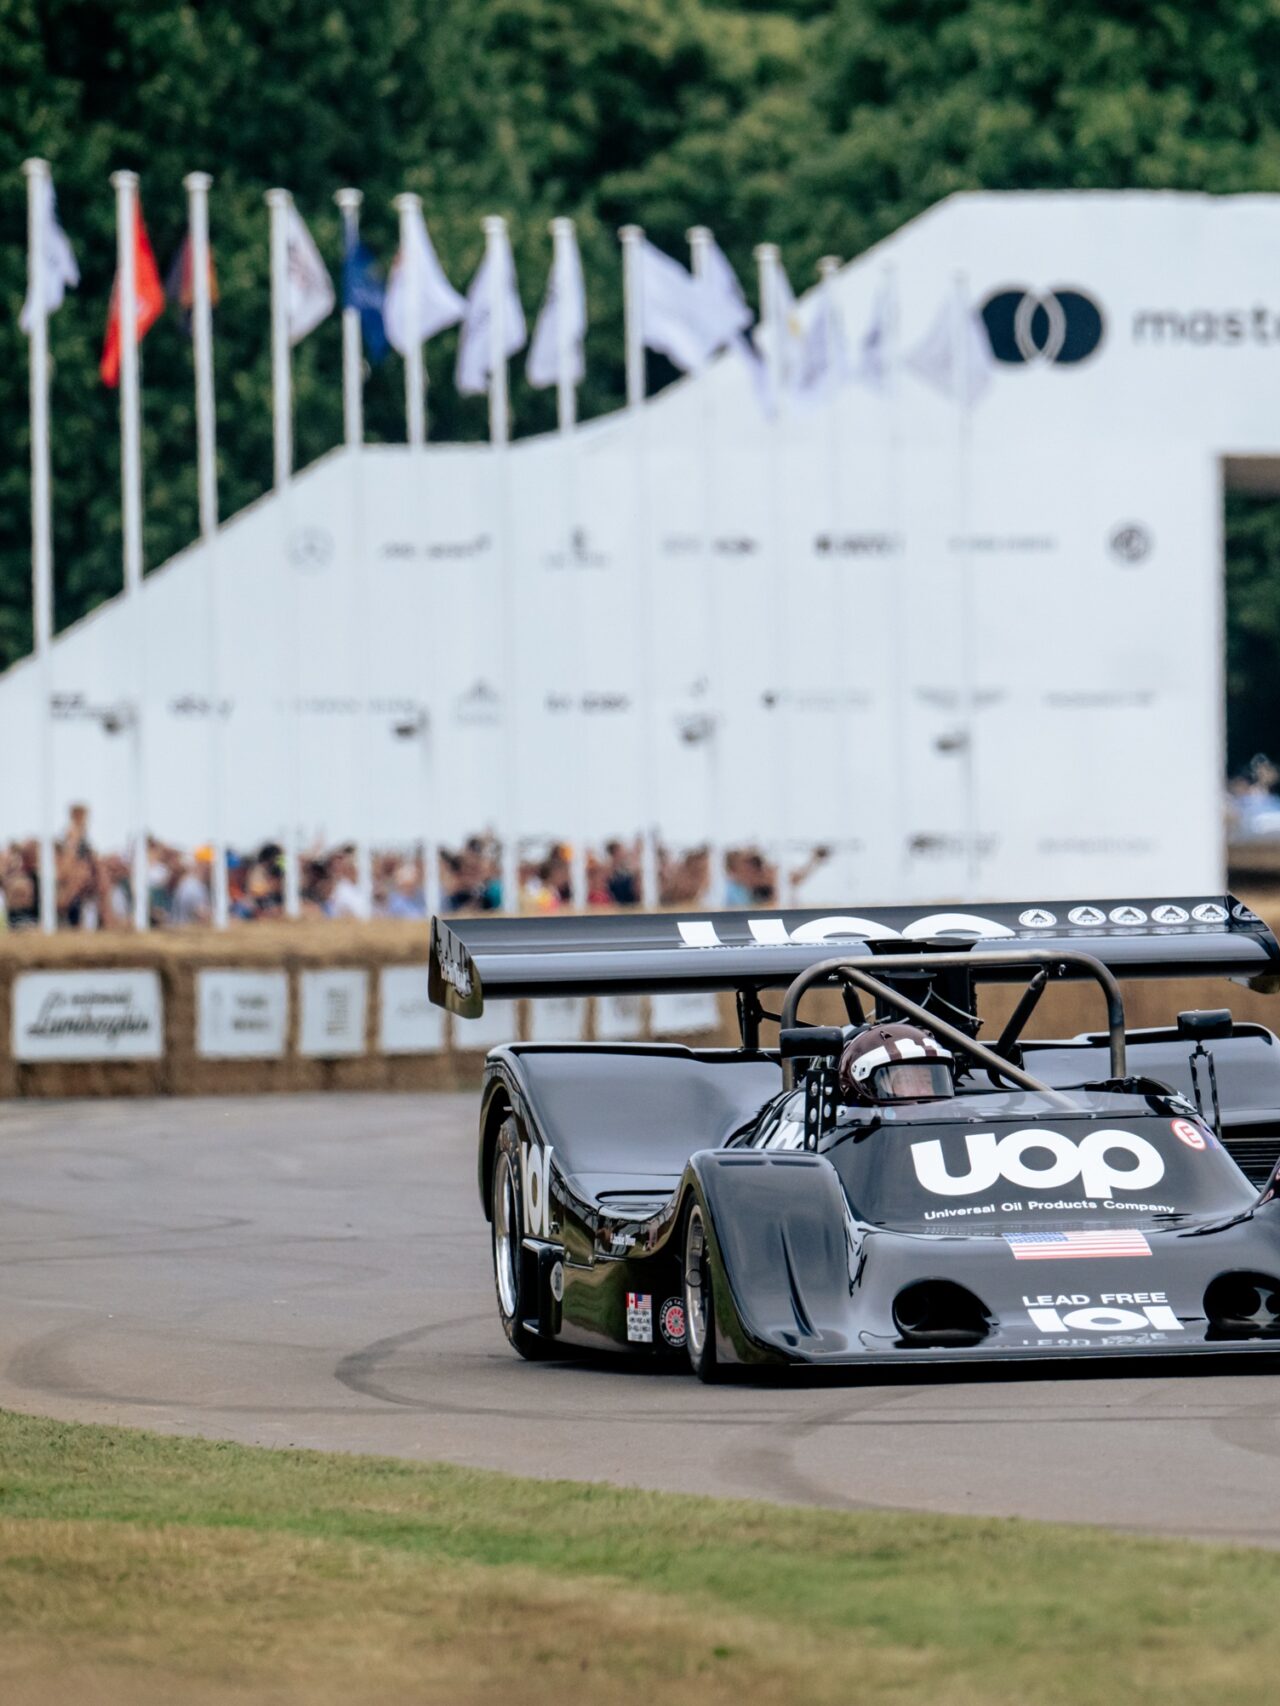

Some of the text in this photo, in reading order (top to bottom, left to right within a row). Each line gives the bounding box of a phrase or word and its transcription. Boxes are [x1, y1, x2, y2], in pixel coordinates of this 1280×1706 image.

[924, 1199, 1175, 1220] Universal Oil Products Company
[1022, 1292, 1168, 1306] LEAD FREE
